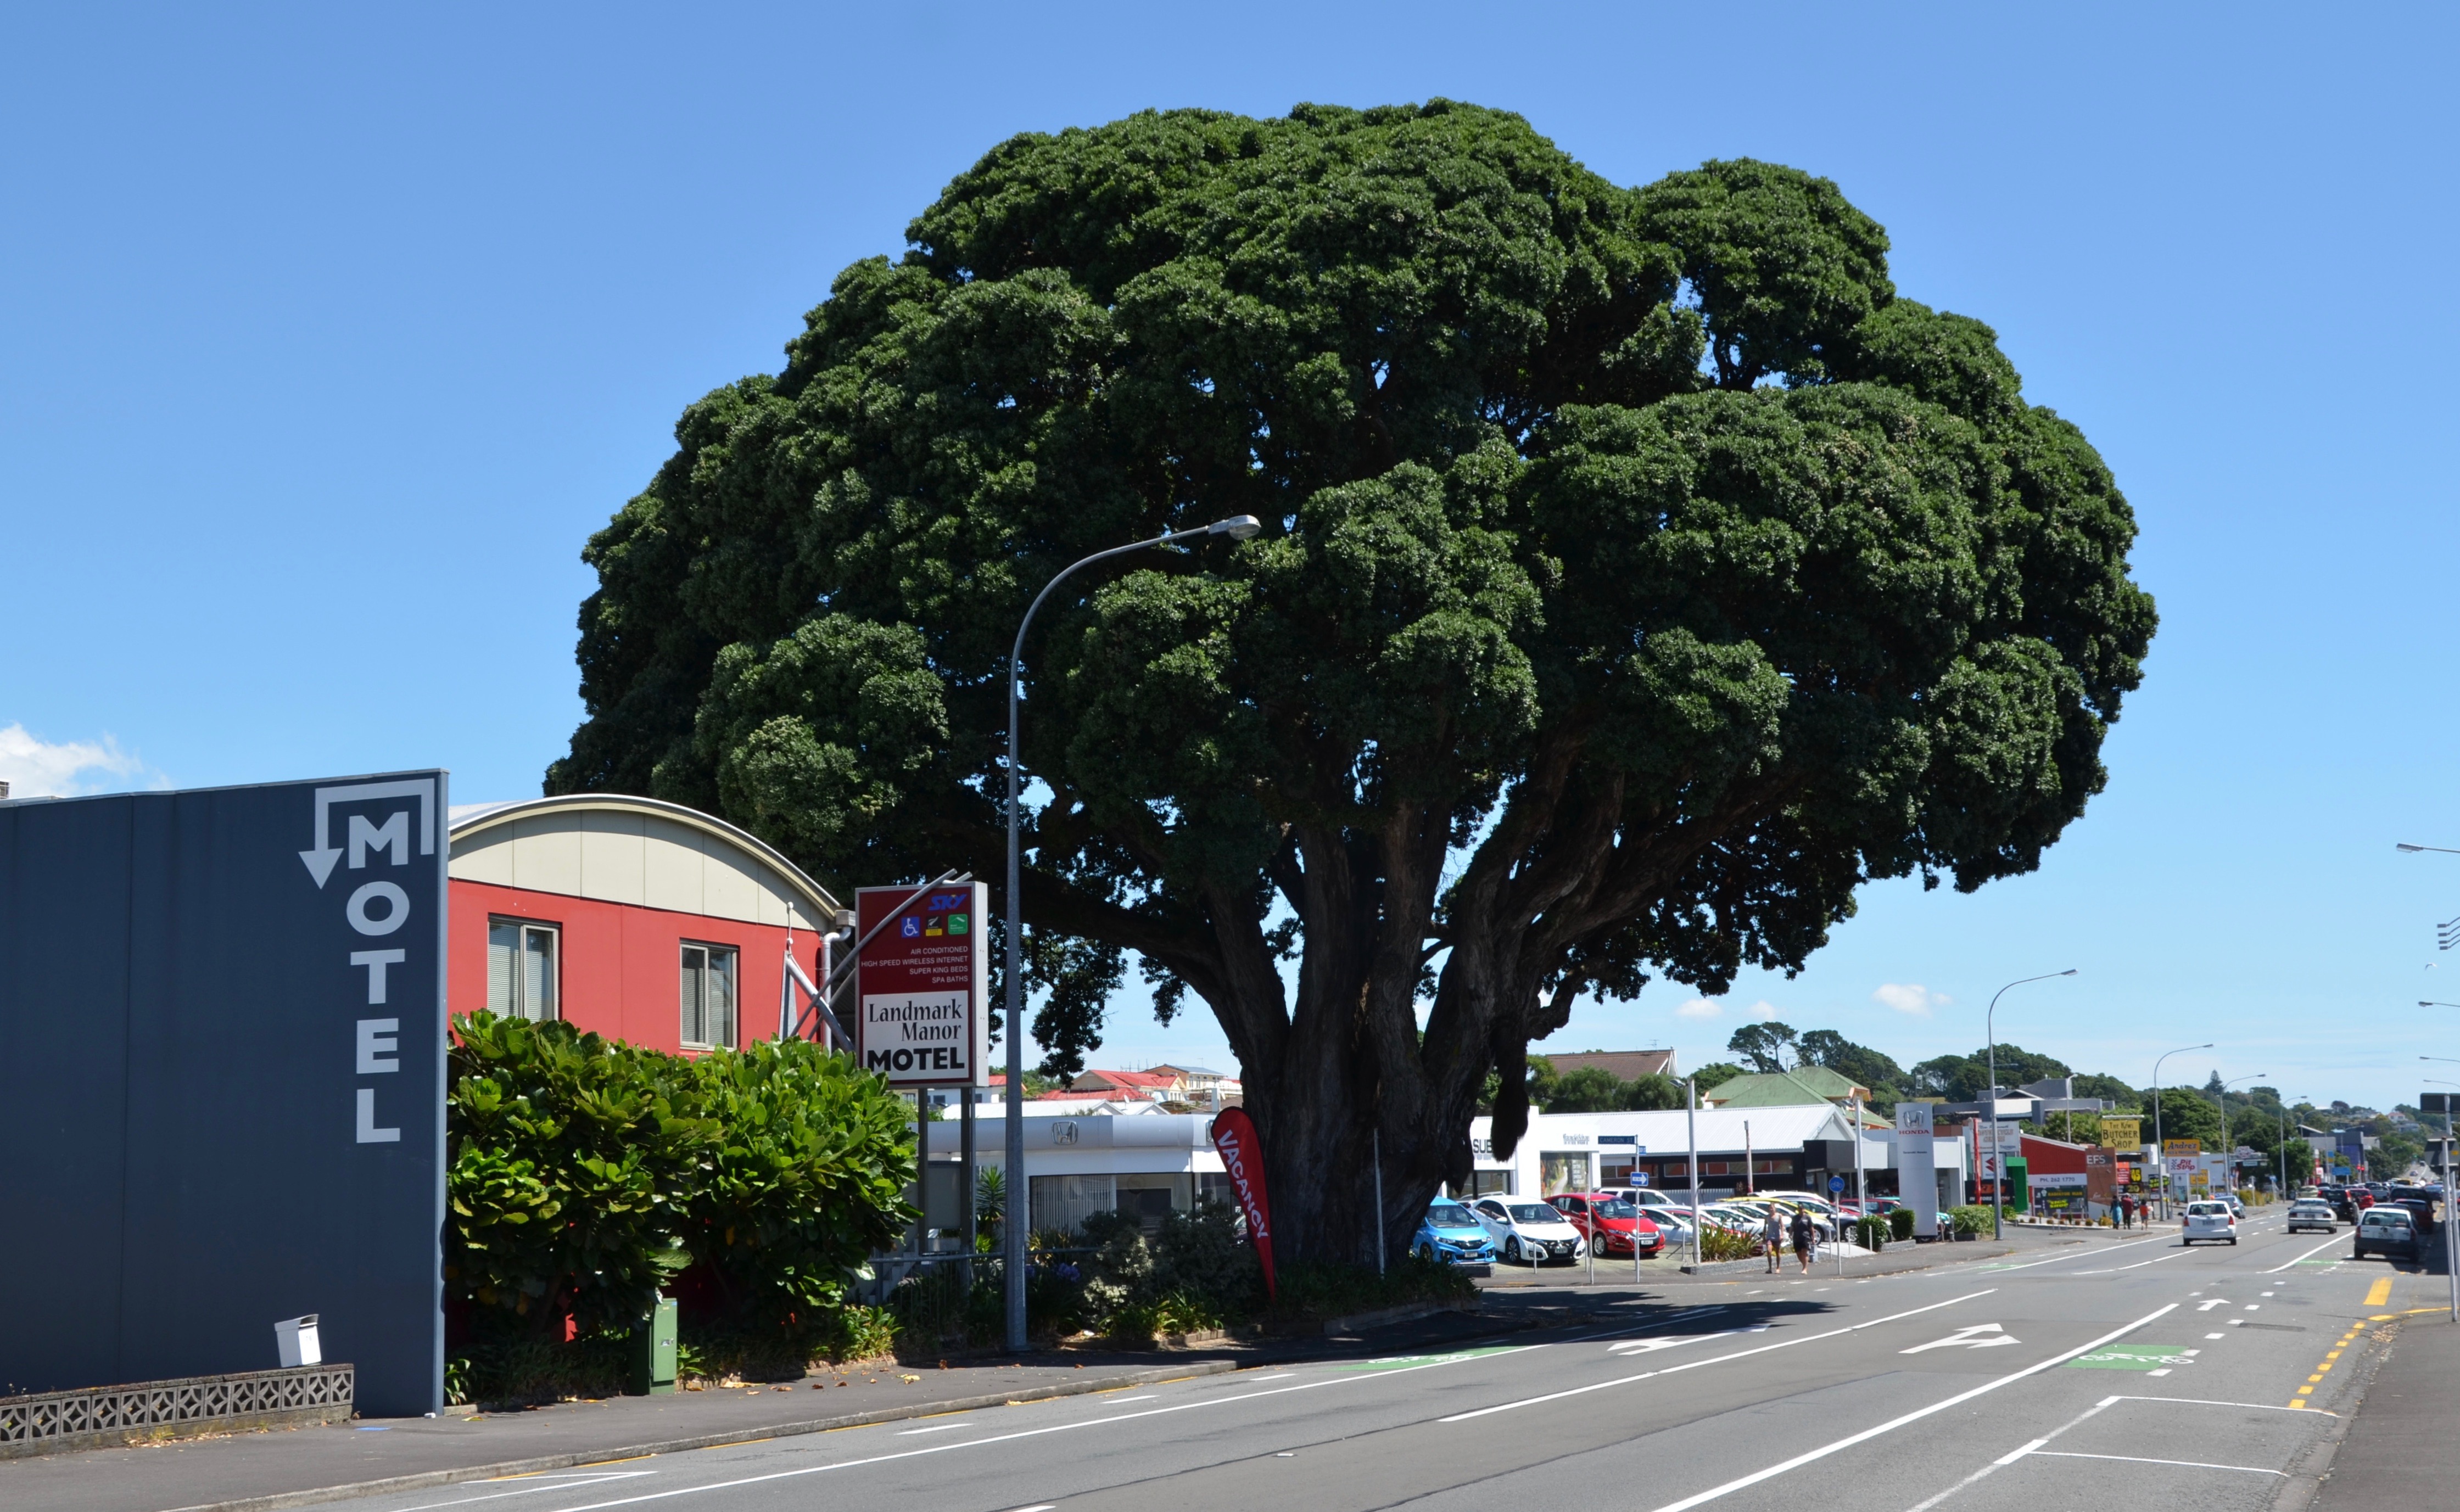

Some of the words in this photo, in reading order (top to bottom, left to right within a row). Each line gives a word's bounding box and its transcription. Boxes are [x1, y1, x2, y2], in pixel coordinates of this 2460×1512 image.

[928, 894, 967, 911] SKY
[923, 946, 969, 955] CONDITIONED
[346, 811, 410, 1143] MOTEL
[869, 998, 963, 1023] Landmark
[901, 1022, 962, 1041] Manor
[867, 1046, 965, 1072] MOTEL
[2103, 1129, 2139, 1140] BUTCHER
[2111, 1139, 2133, 1149] SHOP
[2087, 1155, 2106, 1164] EFS
[1217, 1129, 1269, 1239] VACANCY
